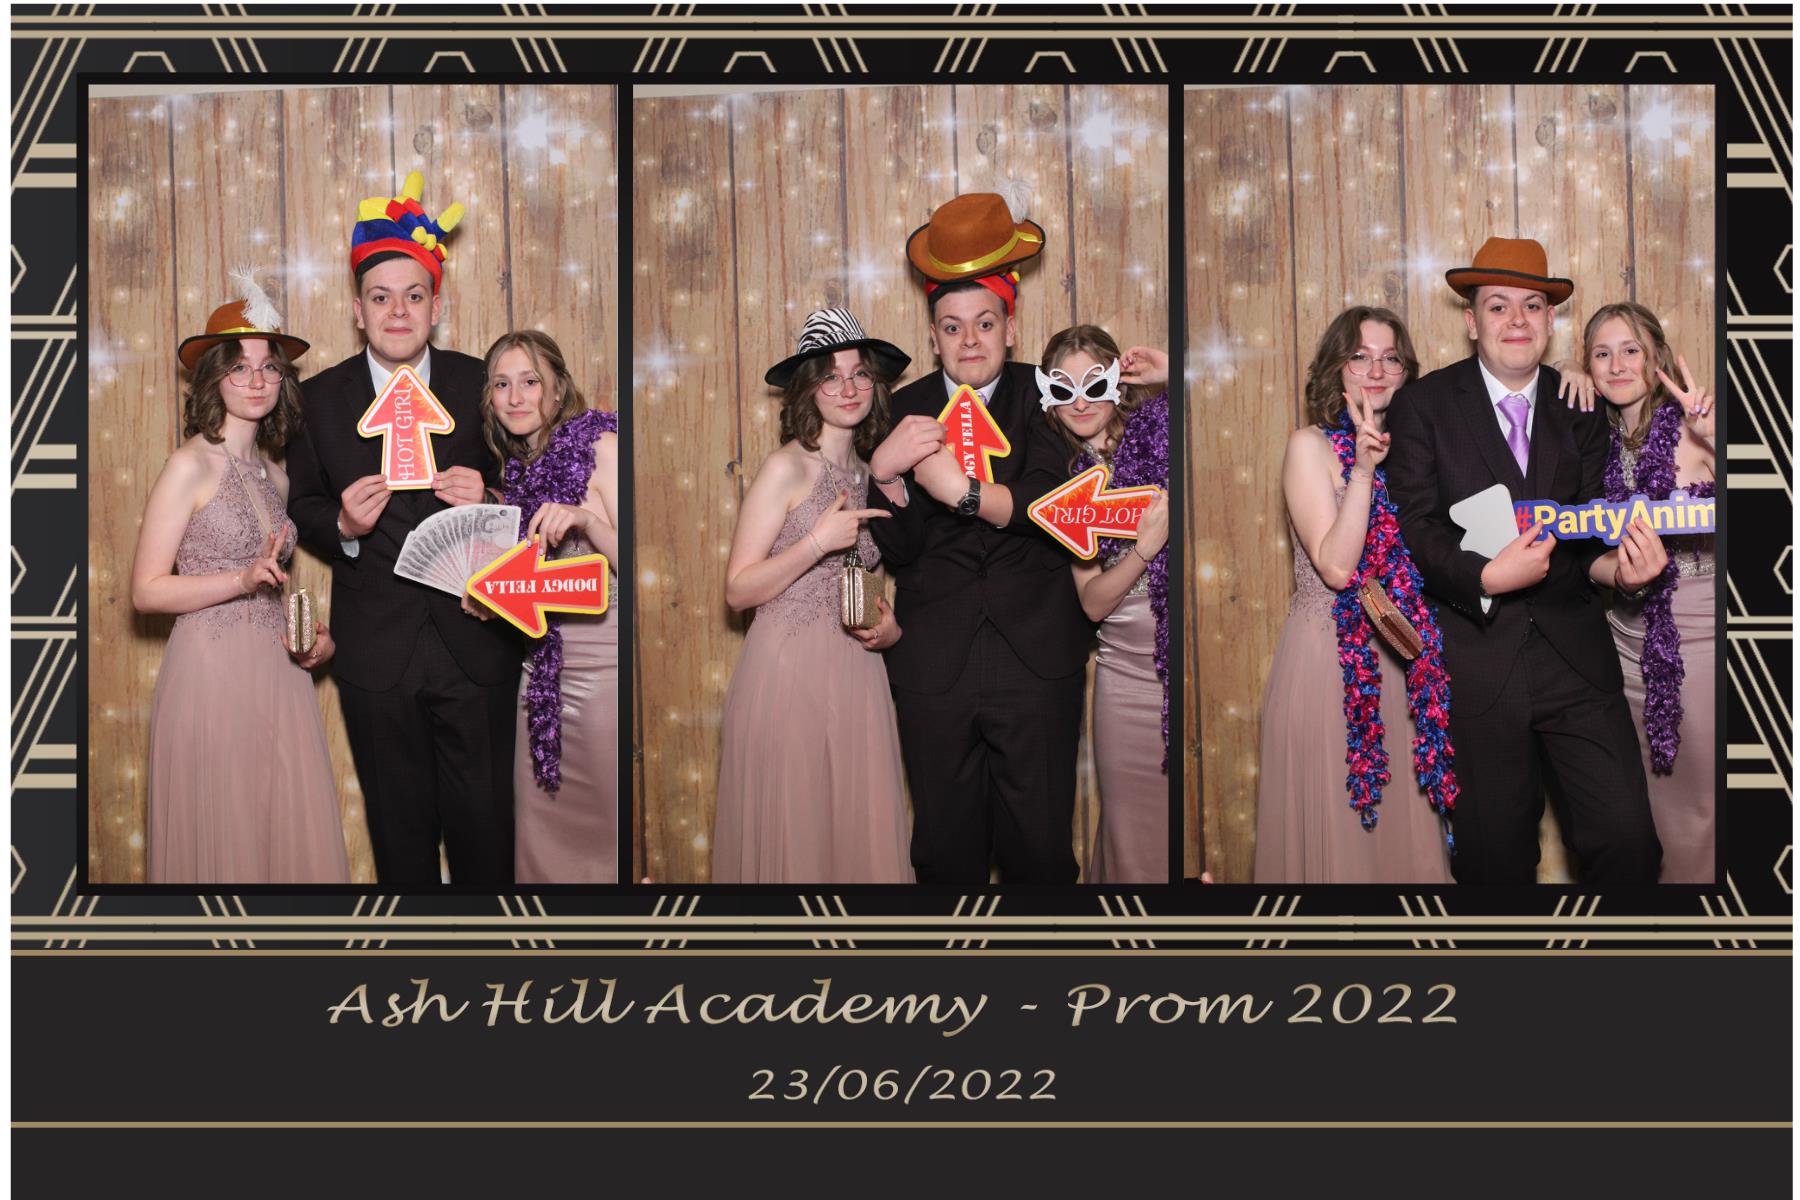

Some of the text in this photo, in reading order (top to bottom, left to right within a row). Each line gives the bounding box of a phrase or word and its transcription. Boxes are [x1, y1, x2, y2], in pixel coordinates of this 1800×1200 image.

[394, 383, 415, 480] HOT GIRL
[960, 400, 975, 447] FELLA
[1050, 504, 1147, 524] HOT GIRL
[484, 577, 598, 594] DODGY FELLA
